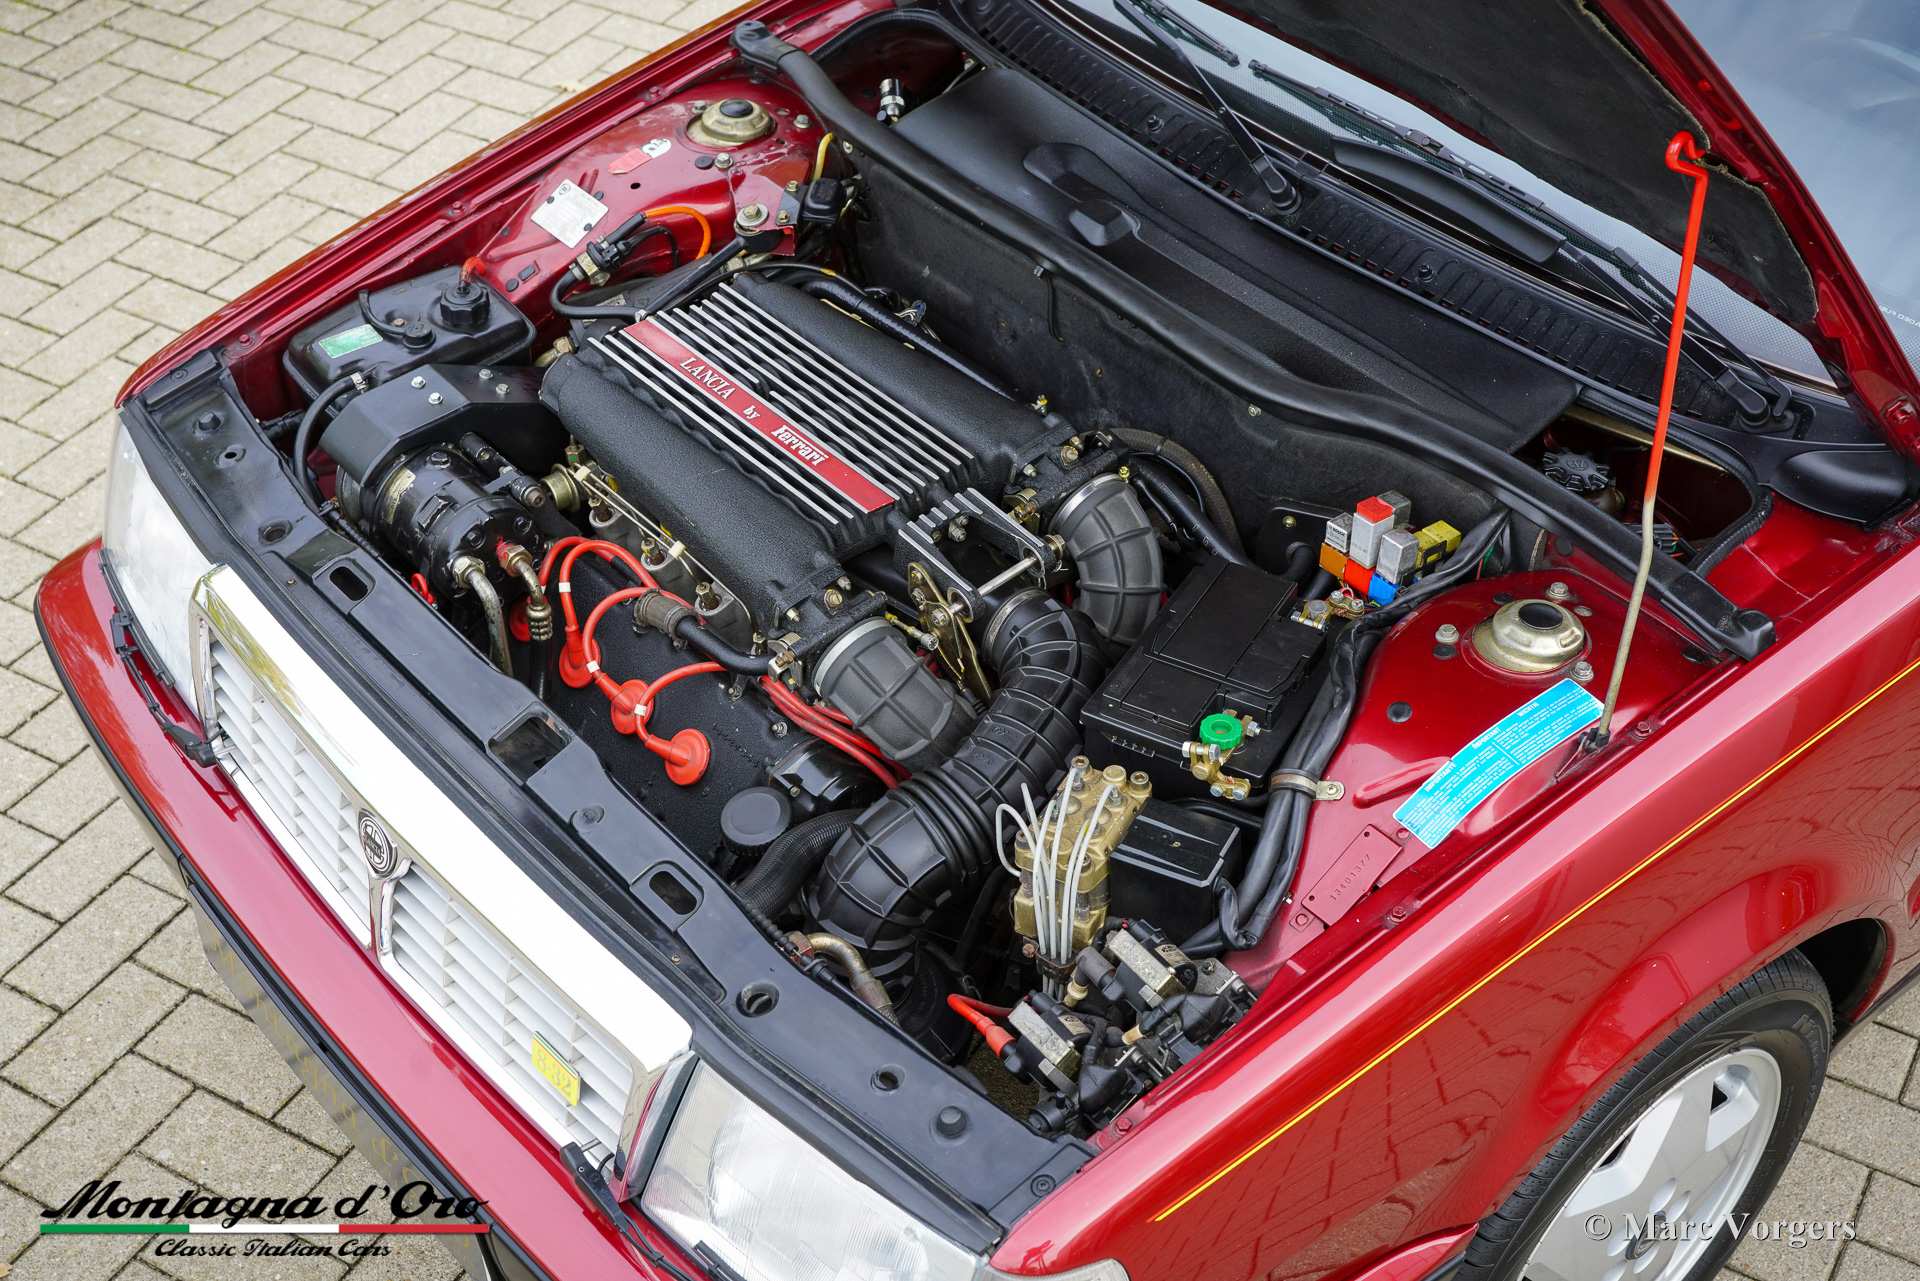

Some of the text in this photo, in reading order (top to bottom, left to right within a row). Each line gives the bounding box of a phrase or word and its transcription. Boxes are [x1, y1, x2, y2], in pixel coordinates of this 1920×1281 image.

[679, 357, 830, 467] LANCIA by Ferrari
[1472, 727, 1501, 749] IMPORTANT
